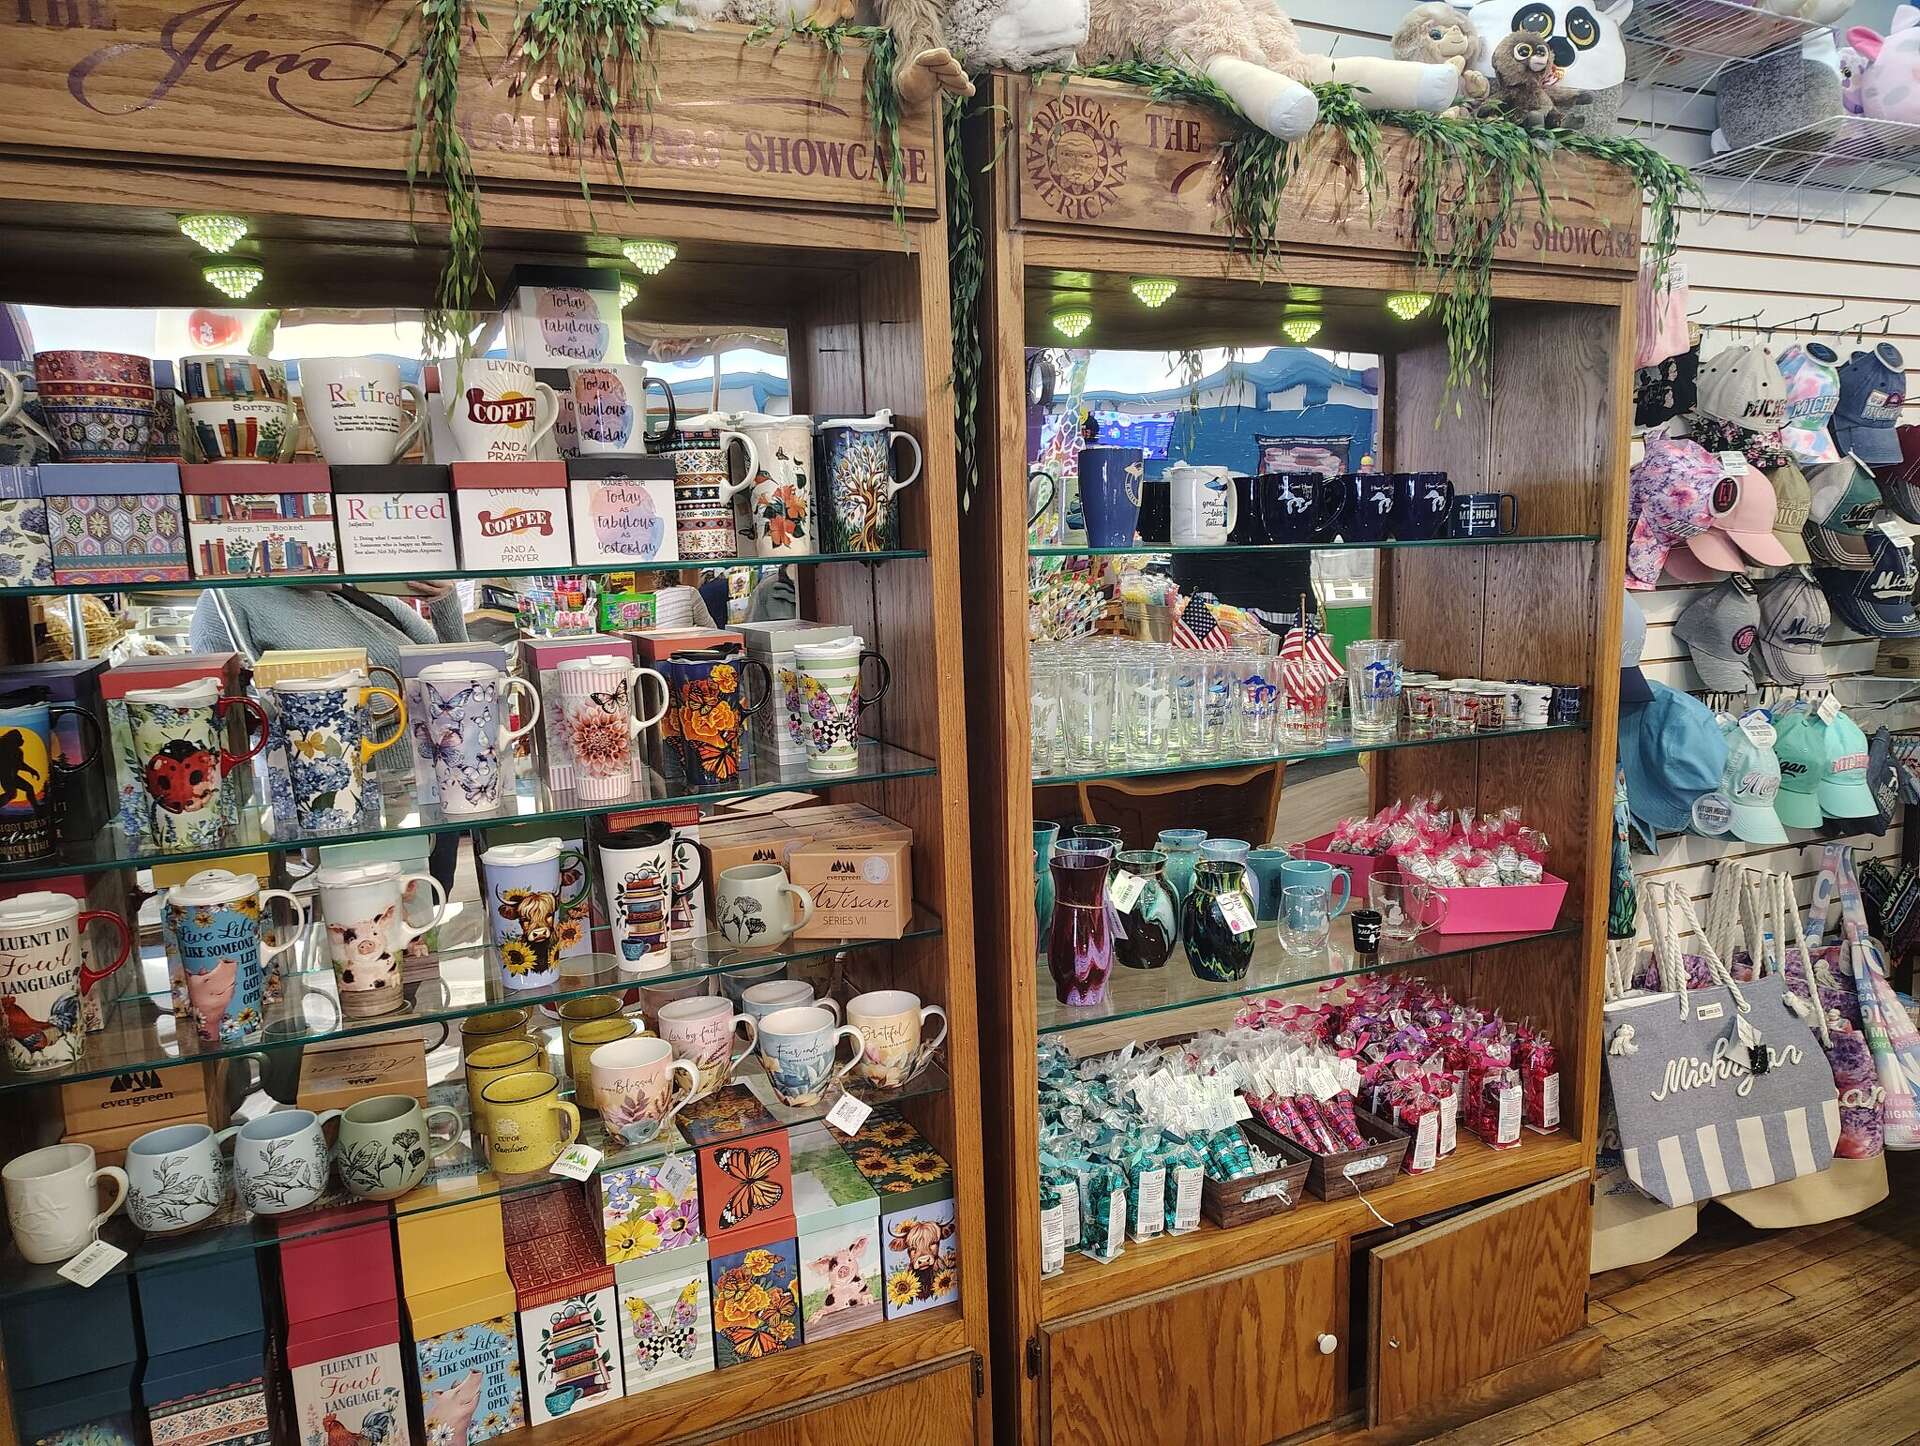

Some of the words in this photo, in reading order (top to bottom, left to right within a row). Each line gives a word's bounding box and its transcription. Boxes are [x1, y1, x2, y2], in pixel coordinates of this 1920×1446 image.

[67, 0, 407, 116] Jim
[1034, 94, 1122, 141] DESIGNS
[460, 108, 723, 168] COLLCTORS
[1145, 112, 1201, 152] THE
[1025, 143, 1128, 220] AMERICANA
[1532, 220, 1637, 258] SHOWCASE
[552, 293, 586, 312] Today
[491, 440, 520, 452] AND
[346, 497, 447, 520] Retired
[606, 489, 643, 506] Today
[484, 511, 548, 535] COFFEE
[501, 553, 539, 563] PRAYER
[503, 544, 525, 554] AND
[527, 544, 536, 553] A
[800, 881, 892, 909] Artisan
[823, 915, 853, 926] SERIES
[854, 915, 867, 926] VII
[56, 926, 69, 942] IN
[184, 944, 206, 958] LIKE
[206, 936, 255, 958] SOMEONE
[240, 949, 258, 965] LEFT
[0, 942, 72, 978] Fowl
[243, 962, 258, 978] THE
[0, 969, 73, 995] LANGUAGE
[101, 1090, 175, 1110] evergreen
[556, 1161, 588, 1174] evergreen
[432, 1345, 467, 1364] Live
[469, 1331, 501, 1352] Life
[320, 1356, 363, 1377] FLUENT
[365, 1352, 378, 1365] IN
[437, 1363, 459, 1378] LIKE
[459, 1349, 501, 1371] SOMEONE
[484, 1359, 506, 1374] LEFT
[320, 1366, 382, 1400] Fowl
[487, 1373, 506, 1385] THE
[325, 1388, 382, 1414] LANGUAGE
[486, 1385, 508, 1399] GATE
[486, 1397, 511, 1411] OPEN
